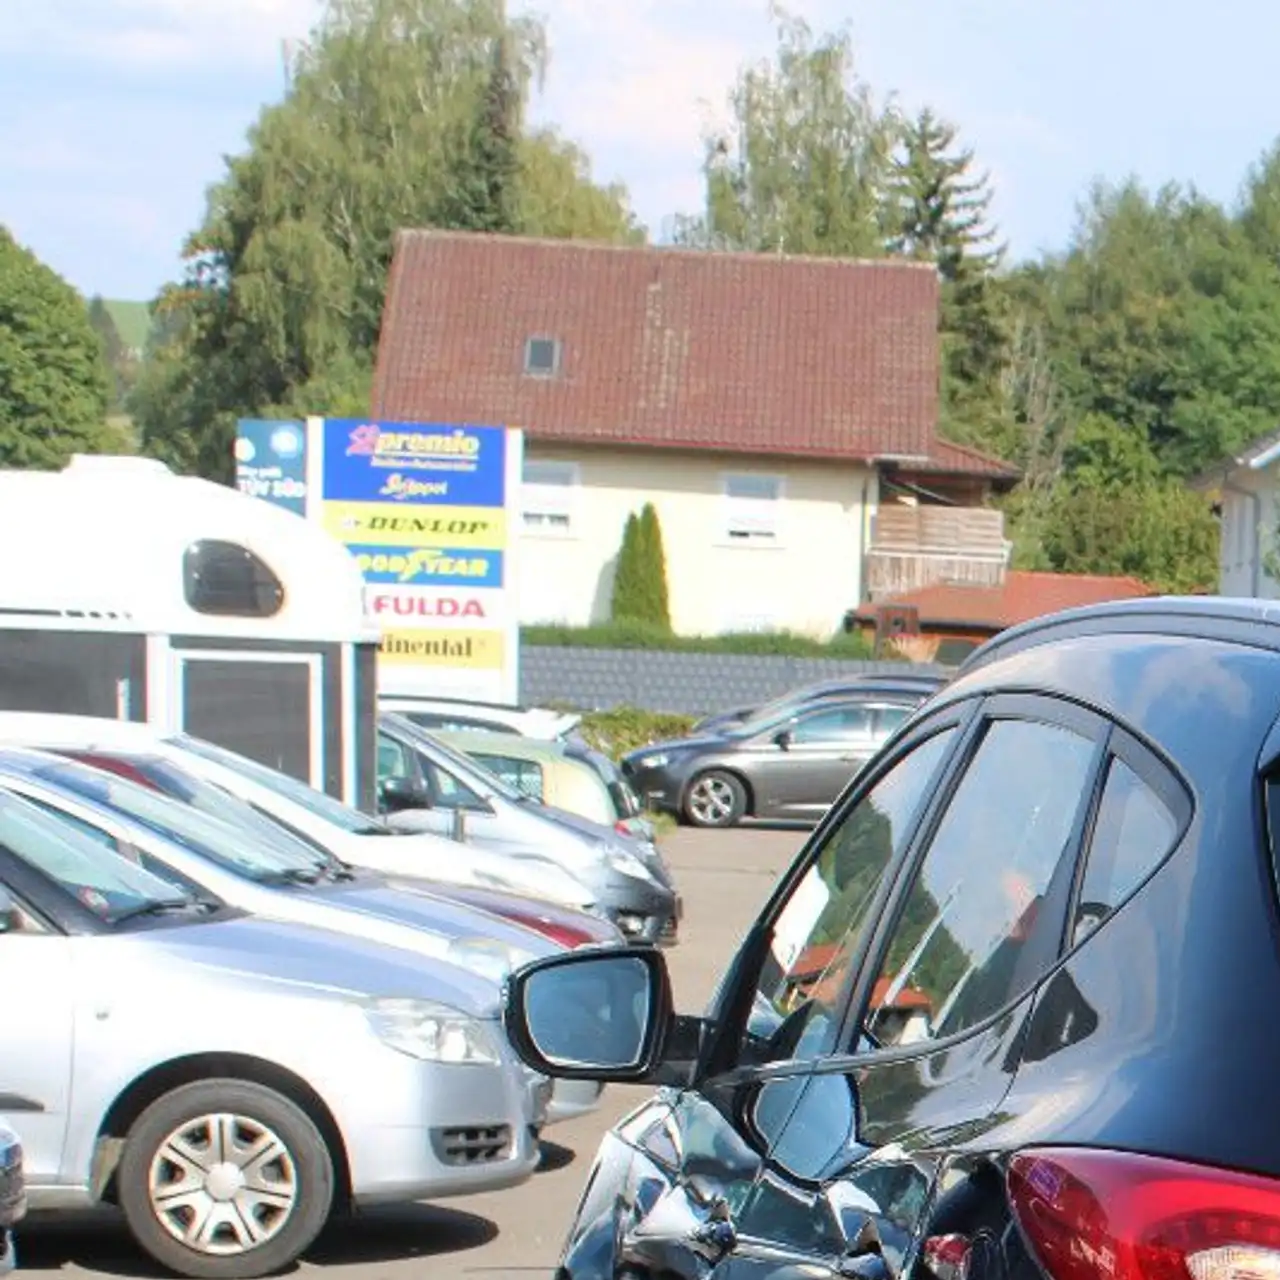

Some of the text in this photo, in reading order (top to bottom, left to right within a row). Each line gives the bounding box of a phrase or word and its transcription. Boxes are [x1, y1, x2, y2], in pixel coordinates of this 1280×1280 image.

[368, 516, 489, 534] DUNLOP
[356, 550, 489, 582] OODYEAR
[373, 595, 487, 618] FULDA
[378, 634, 473, 657] inental
